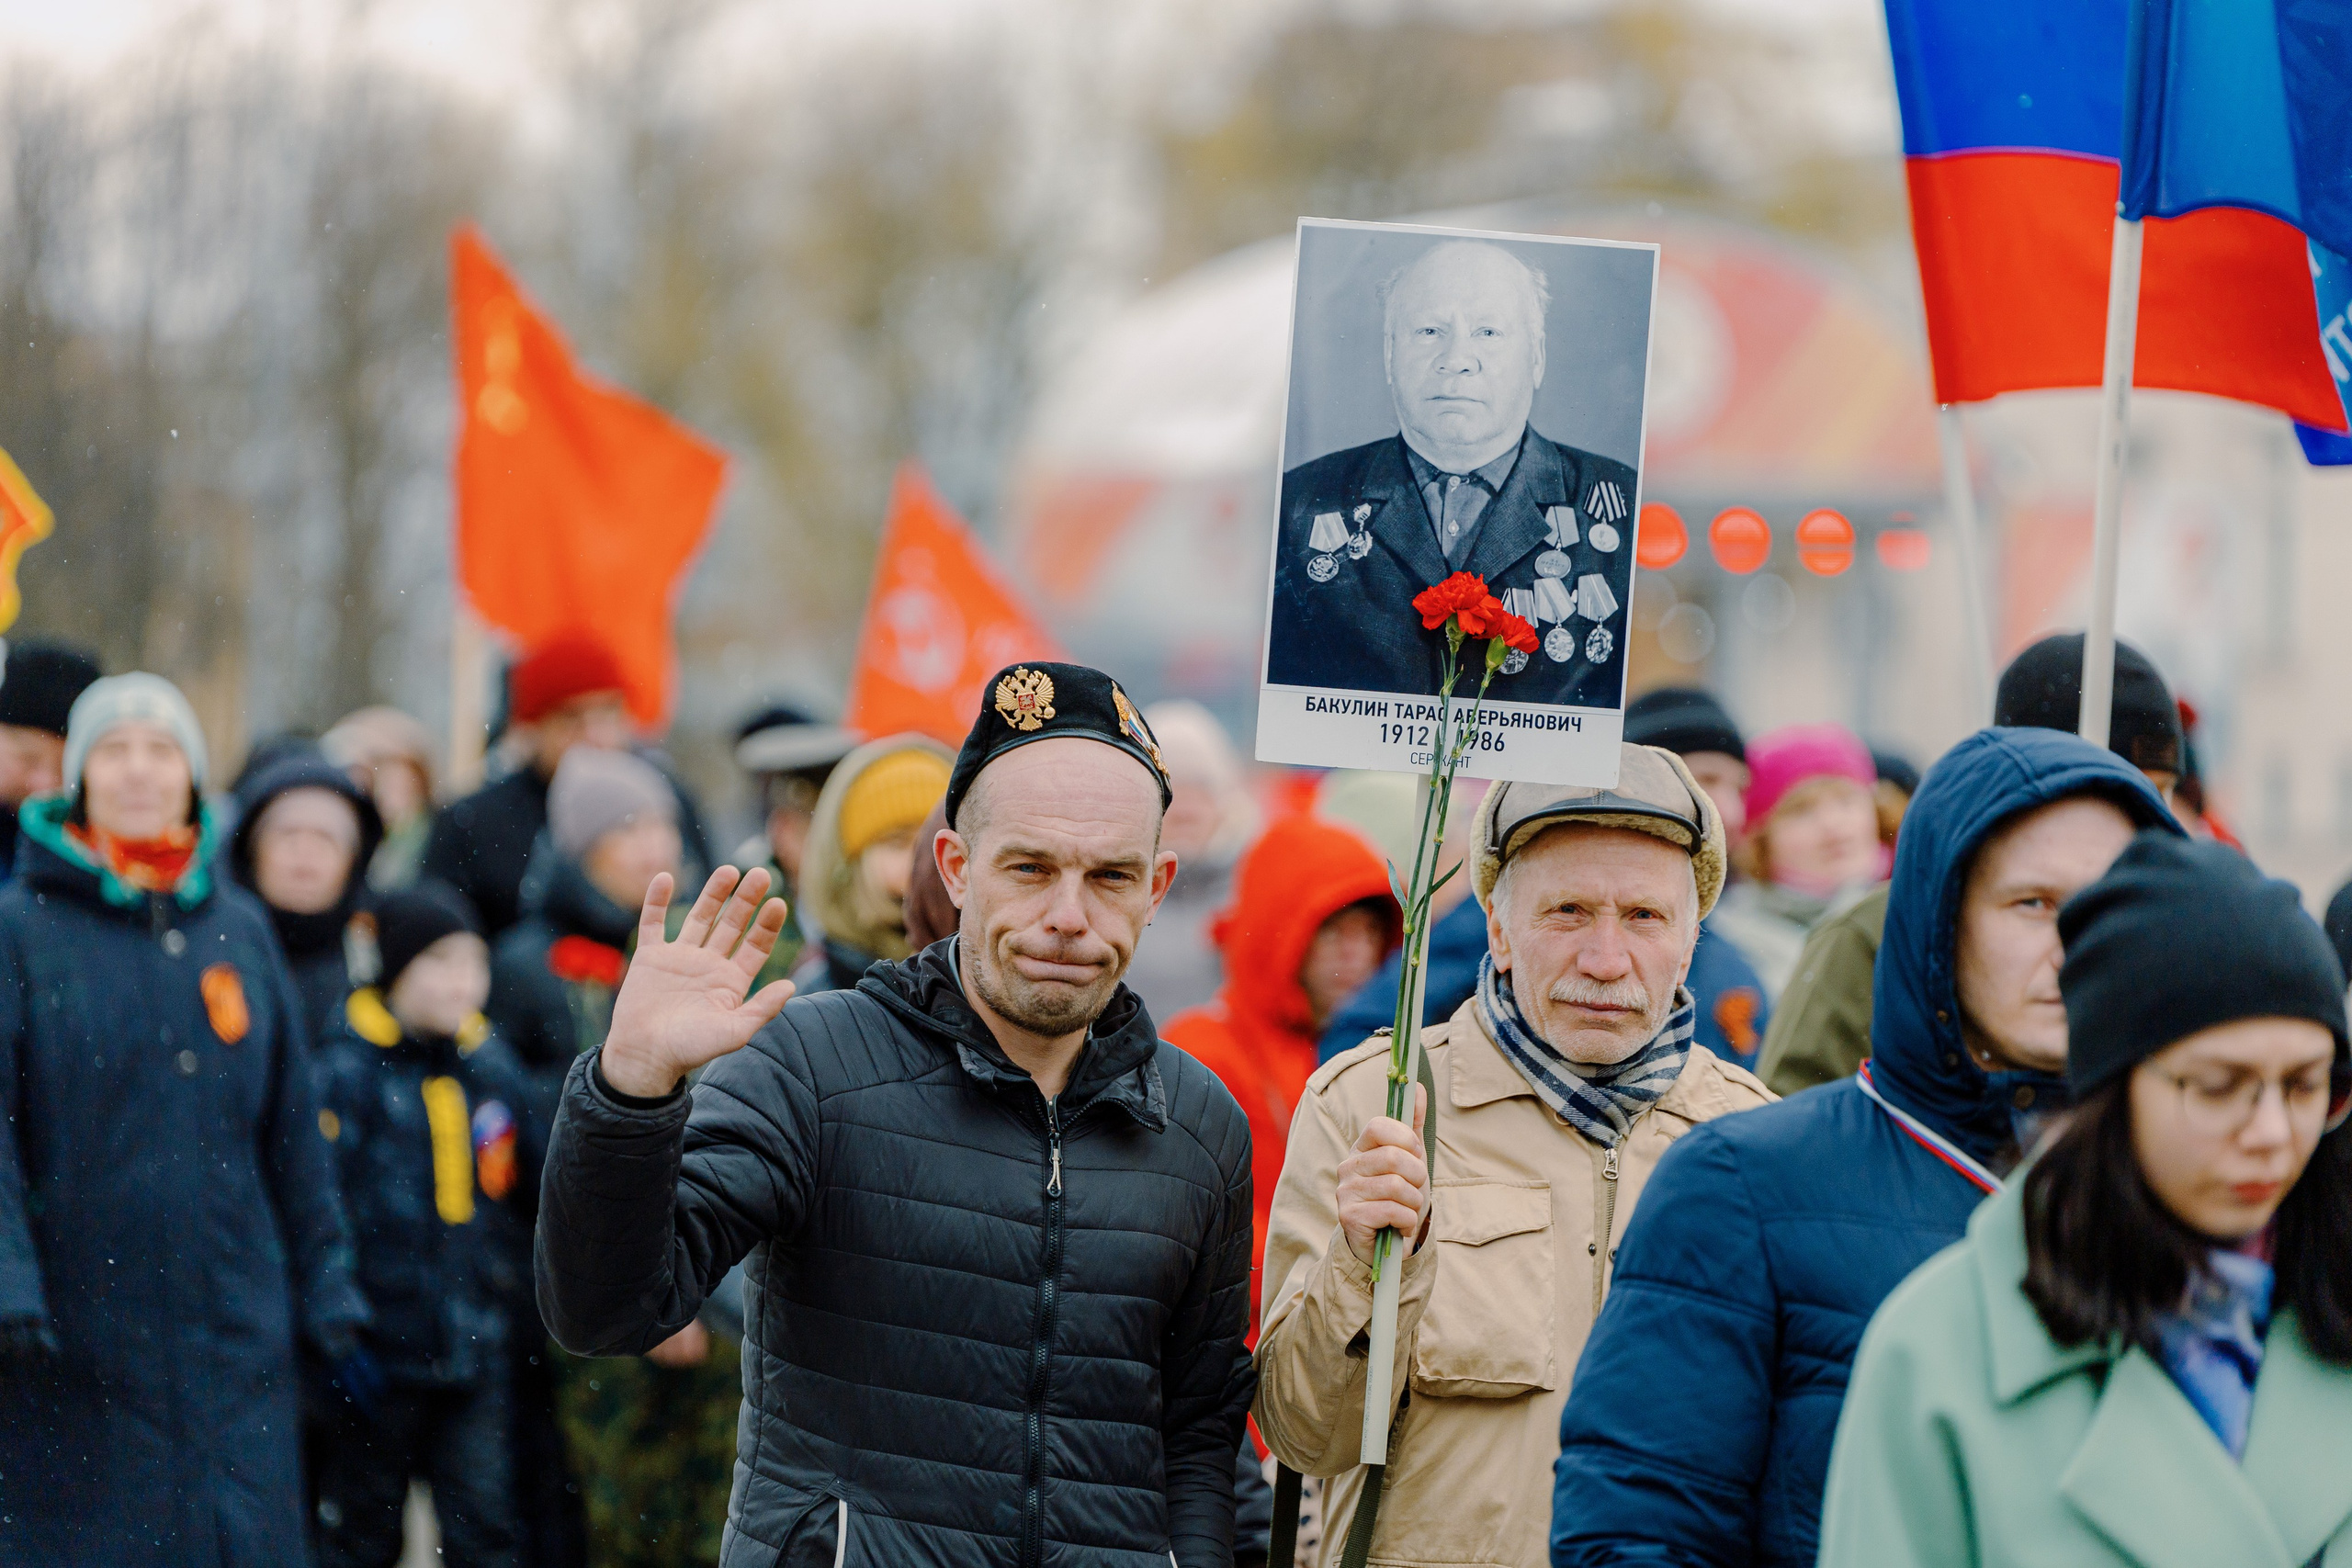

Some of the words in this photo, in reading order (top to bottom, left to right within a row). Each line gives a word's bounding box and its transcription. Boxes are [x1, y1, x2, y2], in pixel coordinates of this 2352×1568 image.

[1306, 695, 1388, 717] БАКУЛИН
[1453, 707, 1582, 732] АВЕРЬЯНОВИЧ
[1380, 723, 1430, 746] 1912
